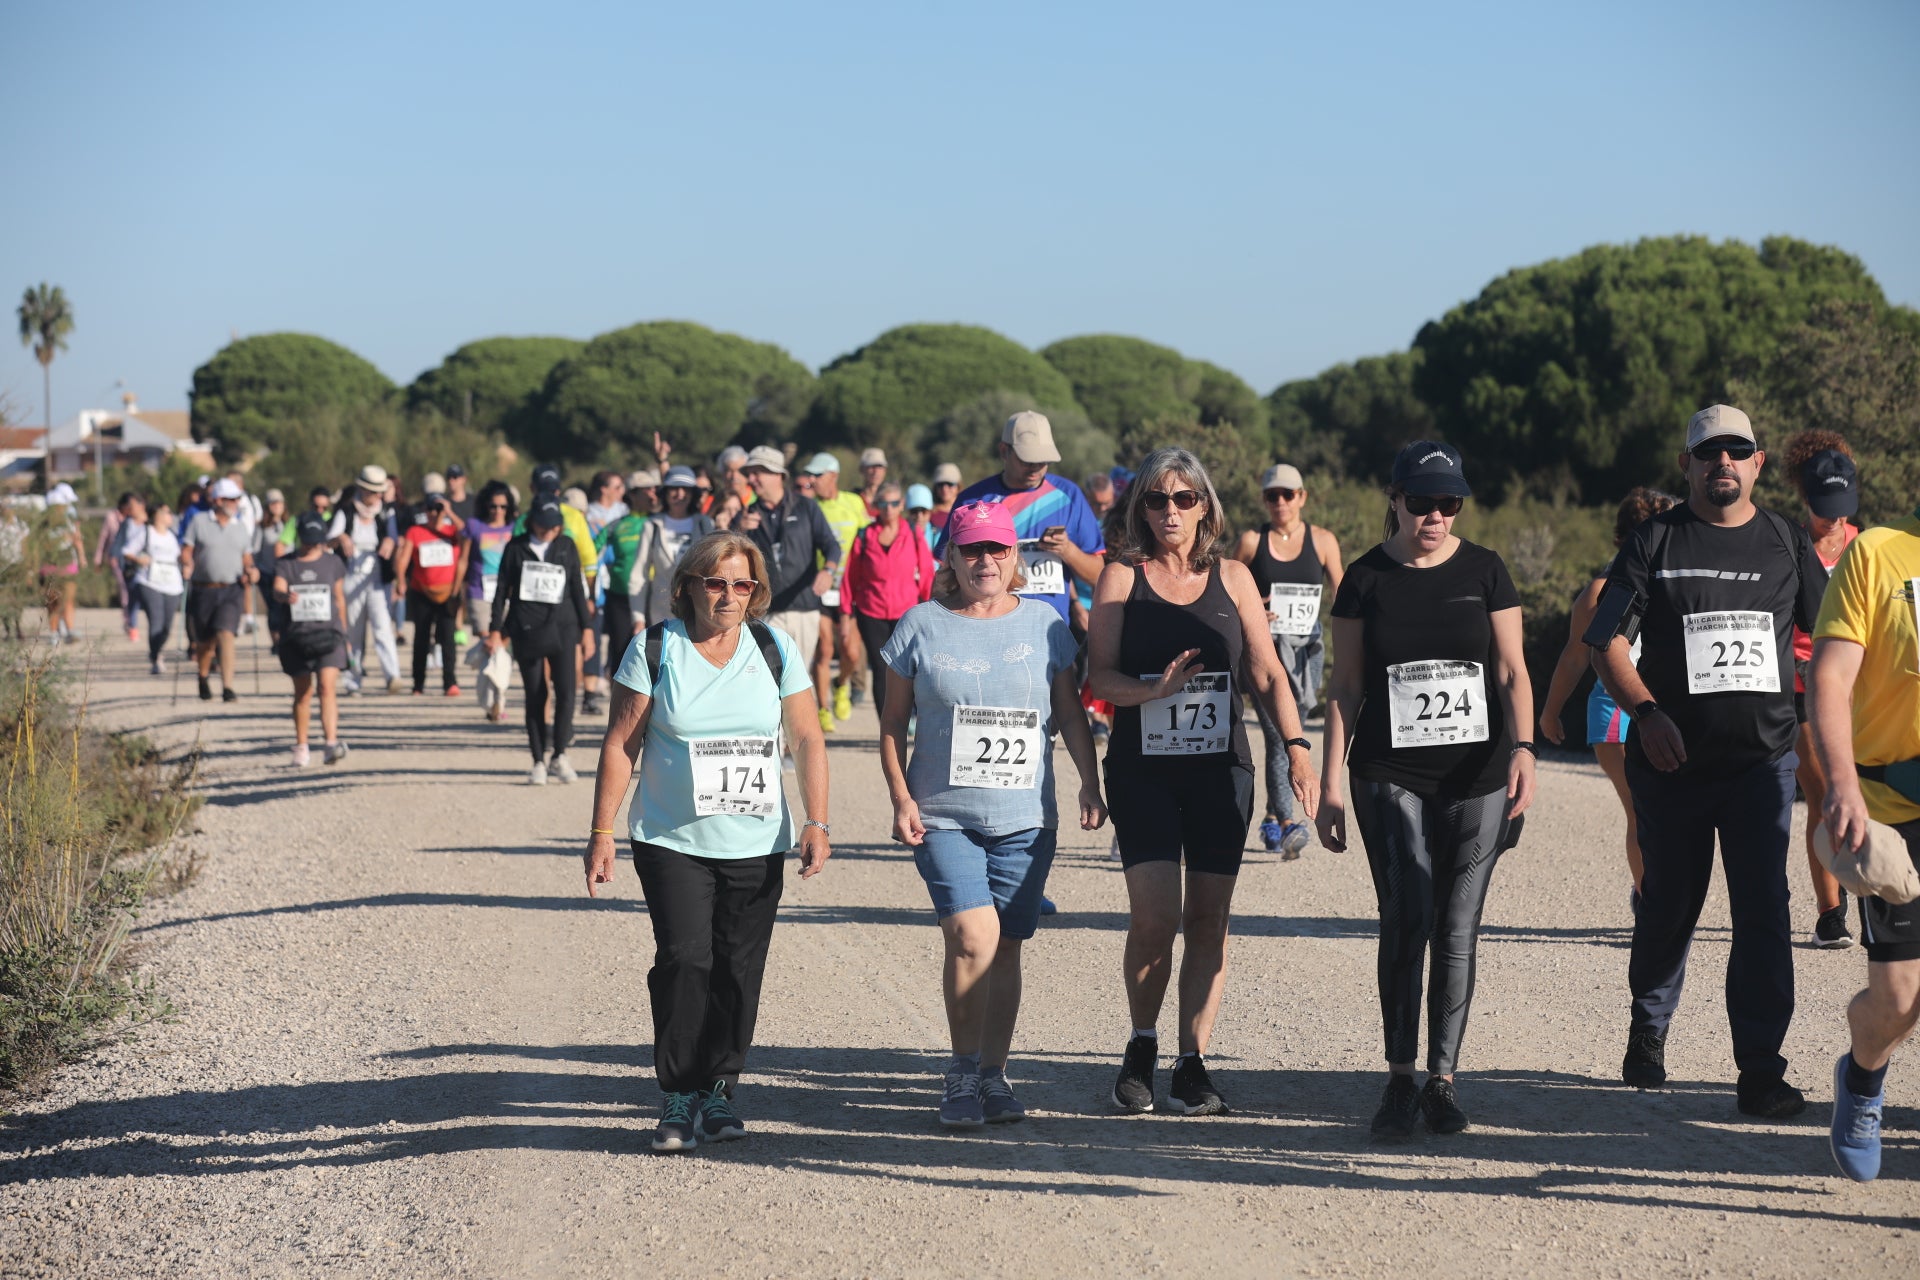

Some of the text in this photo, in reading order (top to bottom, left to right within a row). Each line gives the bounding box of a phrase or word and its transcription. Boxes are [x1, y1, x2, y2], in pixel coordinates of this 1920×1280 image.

[1031, 559, 1053, 577] 60
[1288, 603, 1314, 619] 159
[1701, 615, 1736, 624] CARRERA
[1696, 623, 1729, 631] MARCHA
[1711, 640, 1765, 668] 225
[1400, 673, 1433, 682] MARCHA
[1435, 670, 1467, 678] SOLIDAR
[1405, 664, 1441, 673] CARRERA
[1414, 688, 1472, 720] 224
[1166, 703, 1217, 730] 173
[975, 737, 1027, 764] 222
[717, 766, 766, 794] 174
